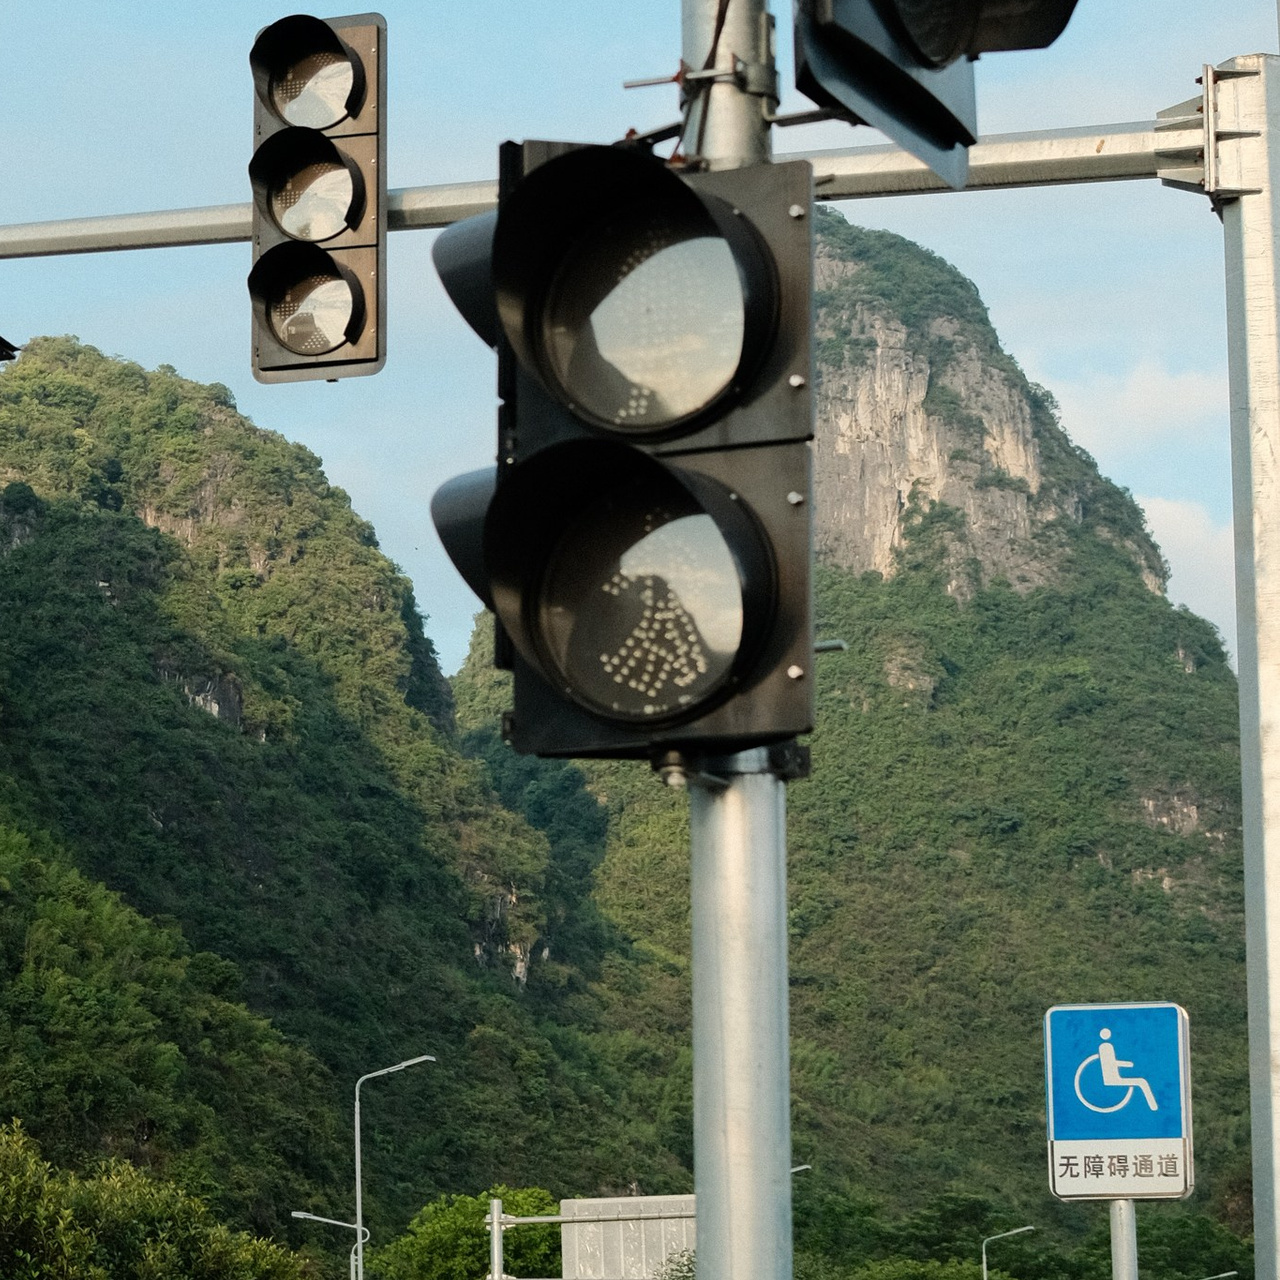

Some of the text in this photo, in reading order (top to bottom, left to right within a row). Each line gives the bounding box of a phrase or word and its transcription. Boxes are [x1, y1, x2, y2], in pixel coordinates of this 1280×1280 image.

[1058, 1153, 1180, 1179] 无障碍通道
